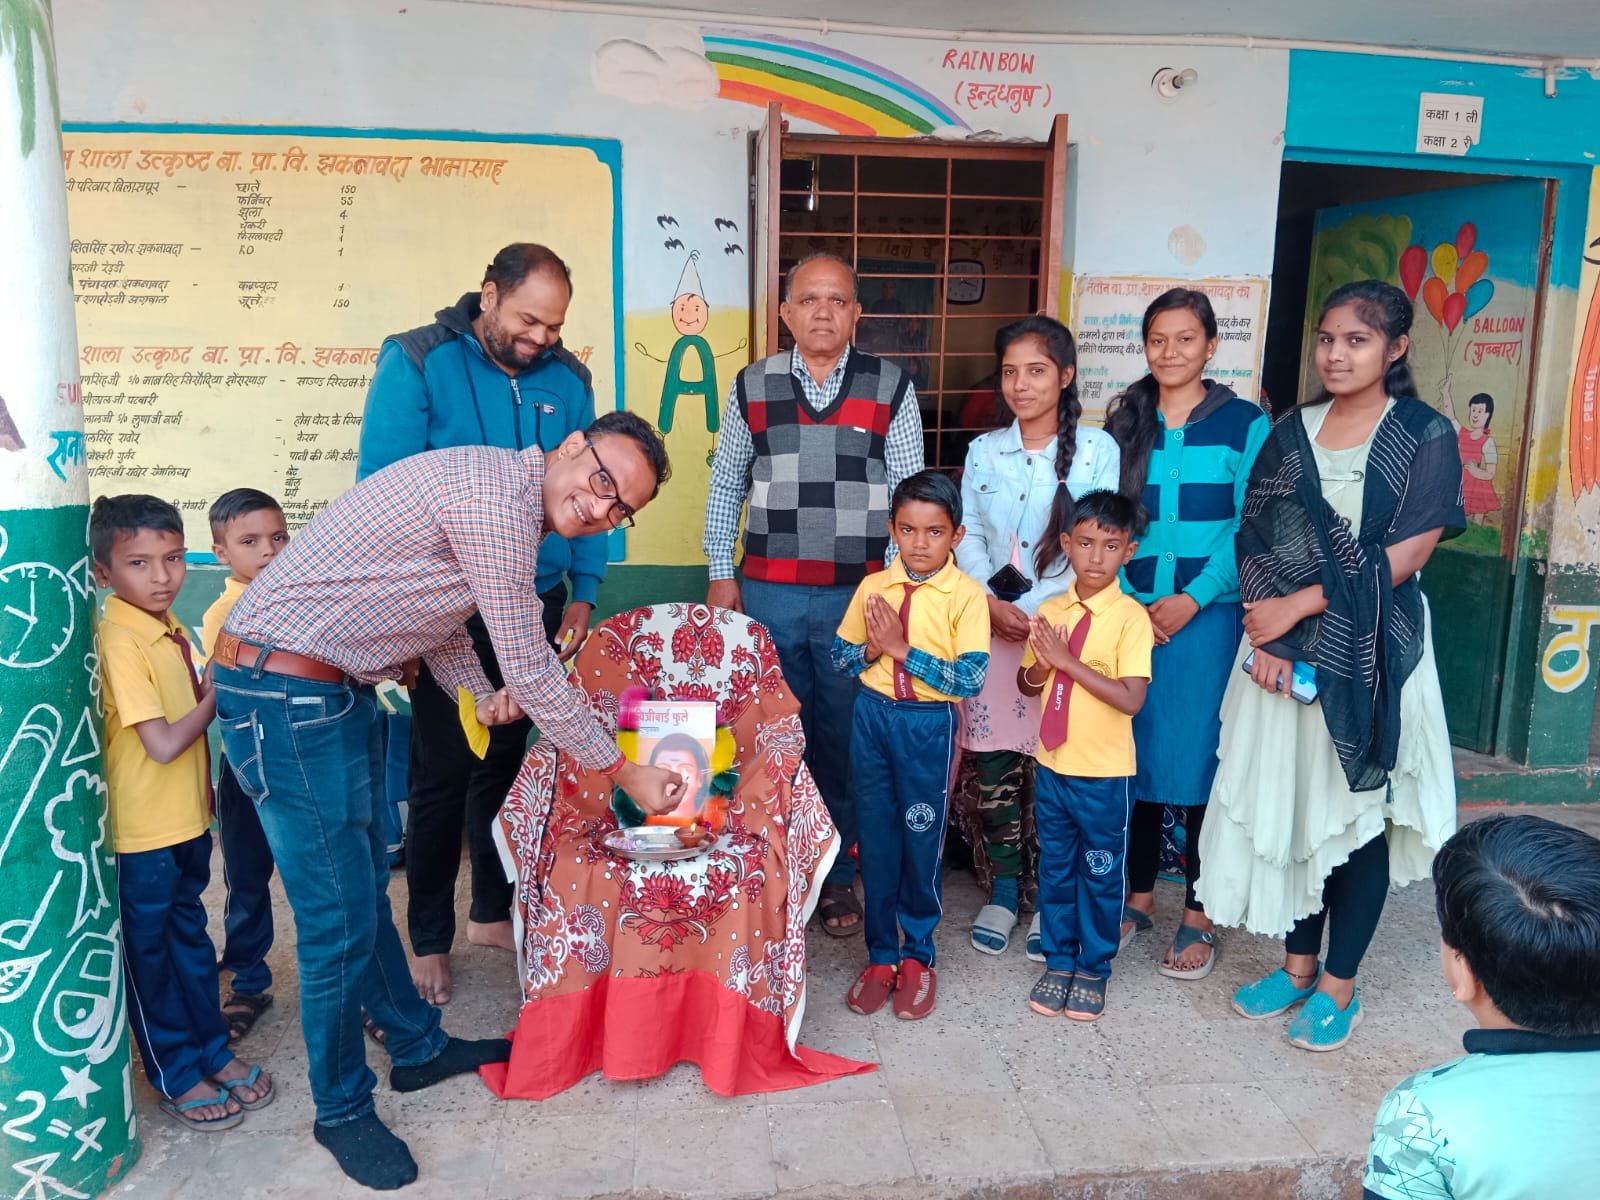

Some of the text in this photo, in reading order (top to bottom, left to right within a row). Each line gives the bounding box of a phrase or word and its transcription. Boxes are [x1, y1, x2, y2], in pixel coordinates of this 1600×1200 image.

[942, 48, 1035, 74] RAINBOW
[1425, 109, 1478, 123] कक्षा 1 ली
[1423, 135, 1446, 147] कक्षा
[1450, 138, 1458, 148] 2
[79, 149, 132, 170] शाला
[136, 150, 214, 177] उत्कृष्ट
[216, 151, 242, 172] बा.
[250, 152, 277, 174] प्रा.
[282, 146, 308, 172] वि.
[77, 178, 111, 192] परिवार
[340, 185, 356, 194] 150
[340, 196, 353, 205] 55
[339, 210, 348, 220] 4
[1237, 286, 1251, 298] का
[333, 298, 350, 309] 150
[1230, 315, 1239, 327] के
[1239, 318, 1252, 328] कर
[1473, 317, 1525, 334] BALLOON
[1126, 343, 1136, 354] की
[80, 345, 124, 365] शाला
[132, 346, 193, 370] उत्कृष्ट
[202, 346, 229, 364] बा.
[239, 347, 271, 367] प्रा.
[276, 342, 306, 365] वि.
[1583, 366, 1599, 422] PENCIL
[331, 412, 343, 425] के
[309, 449, 323, 461] की
